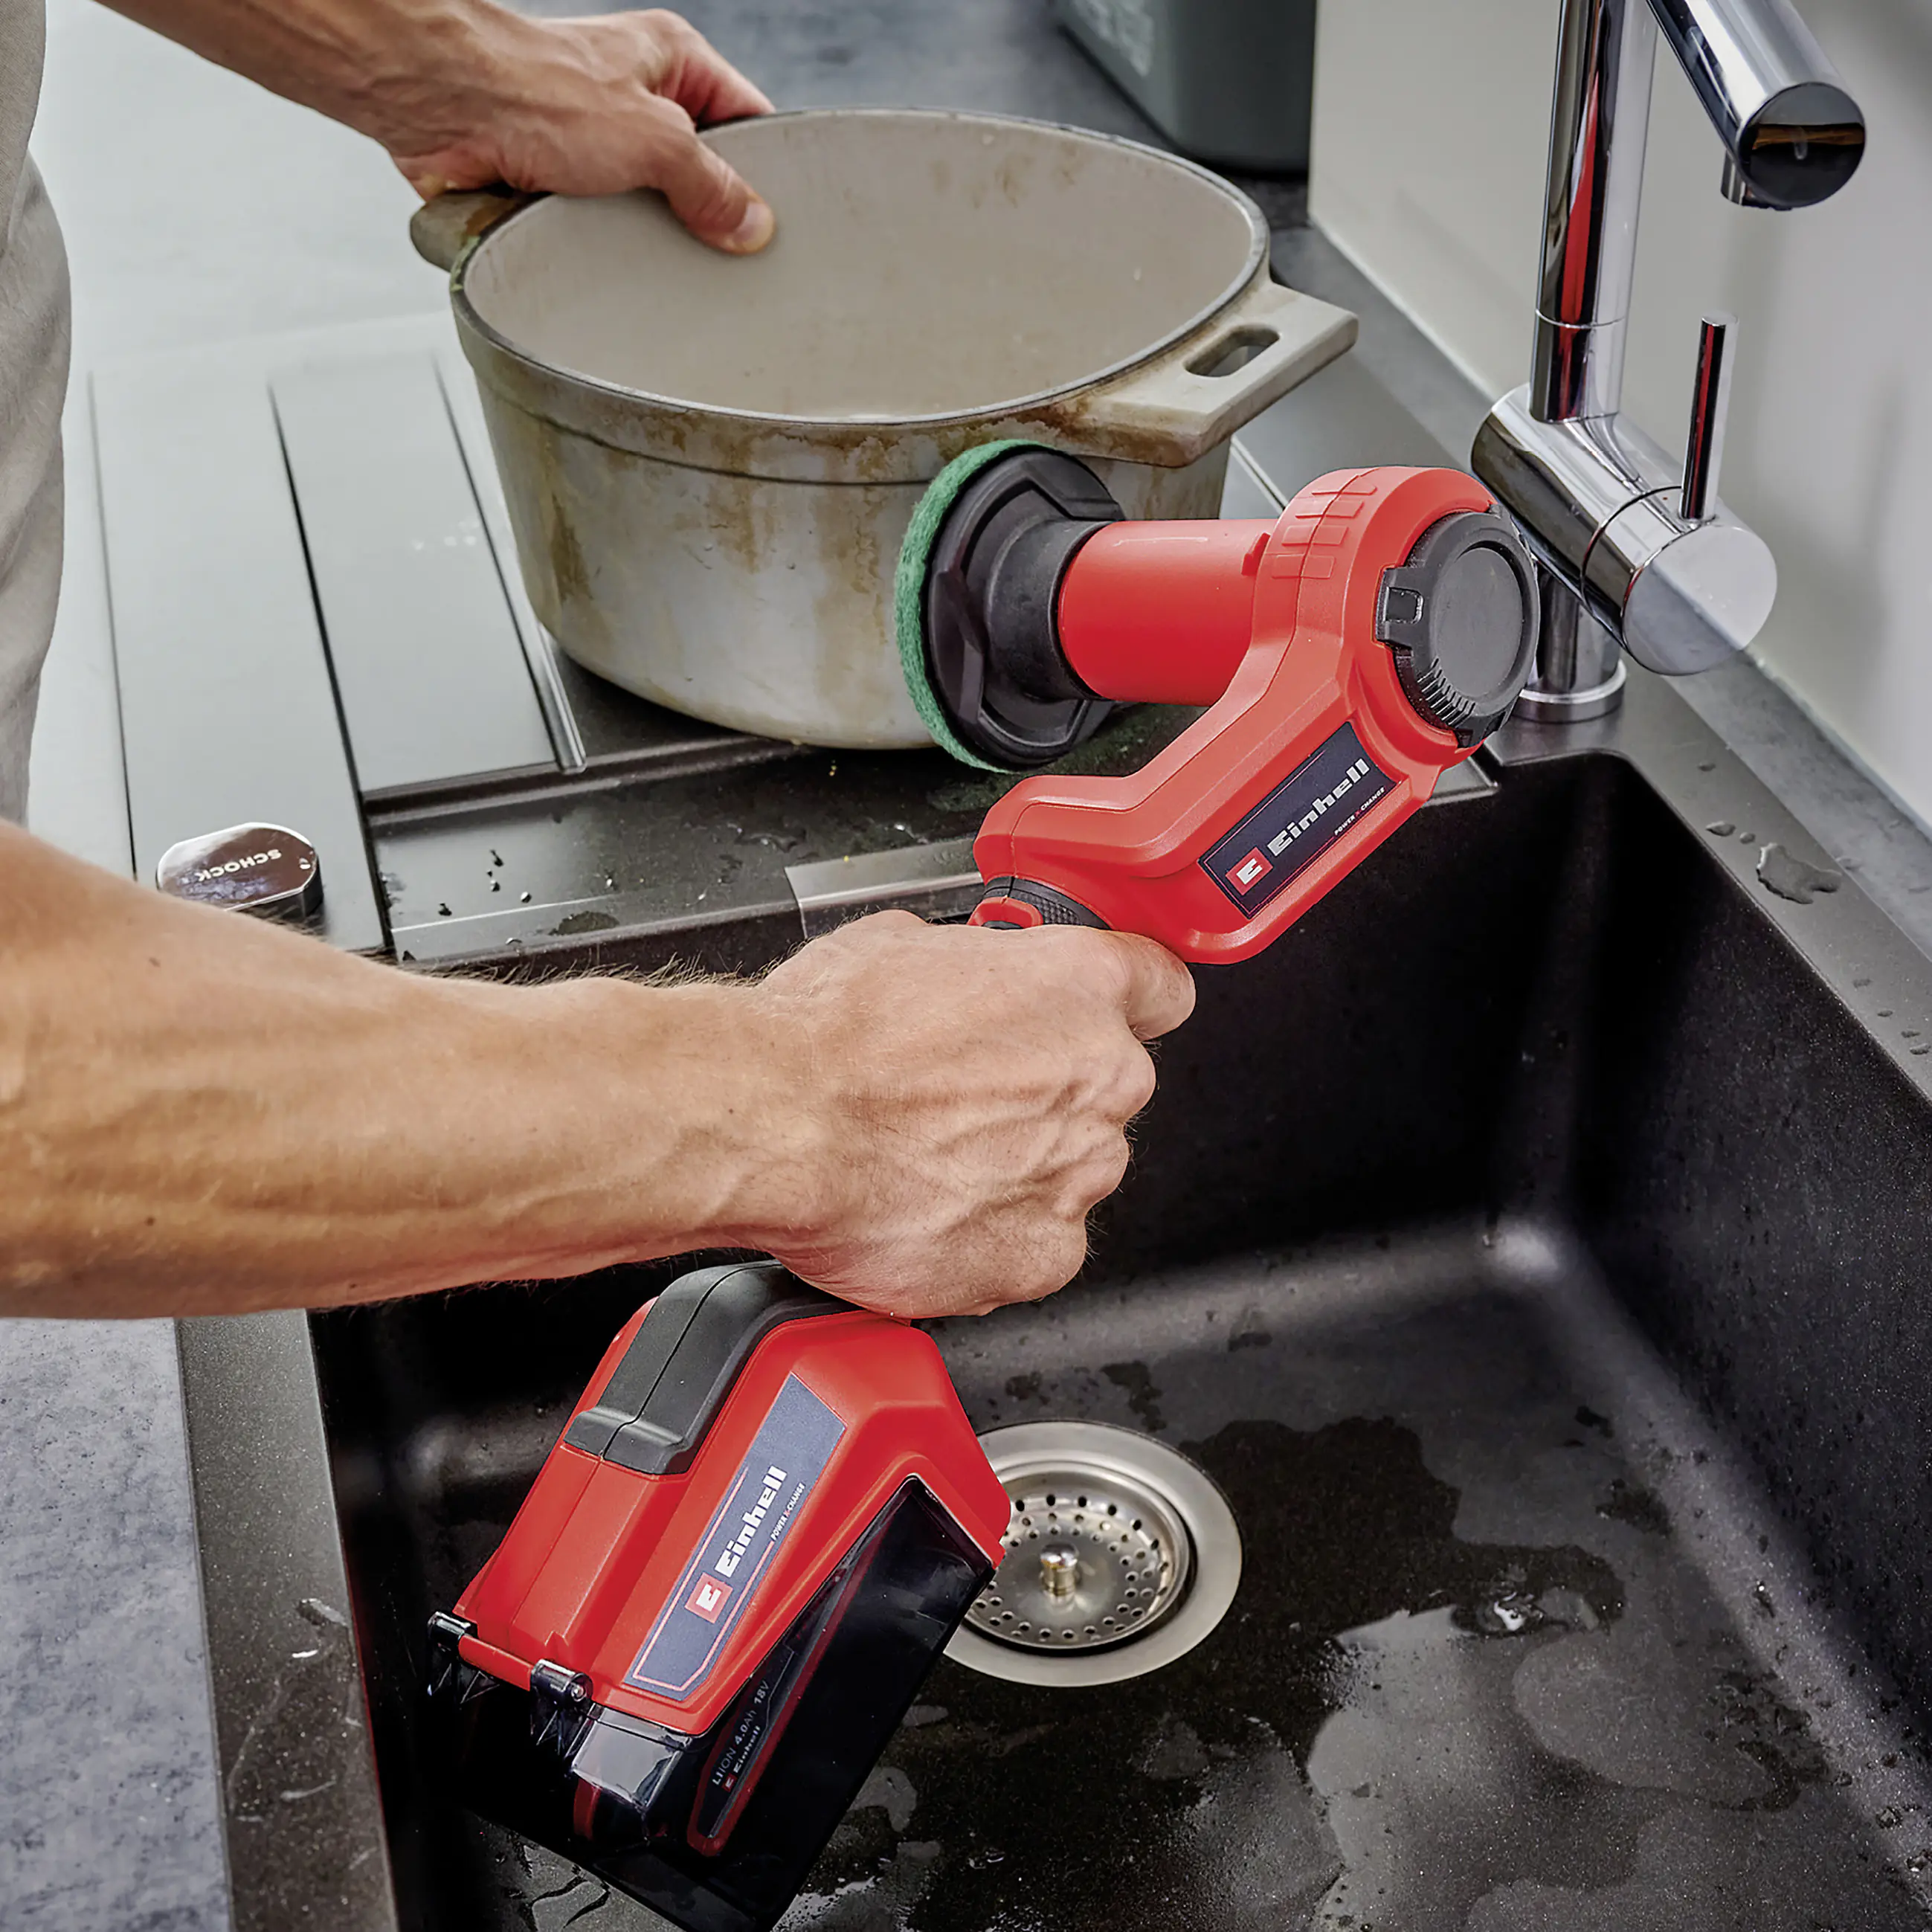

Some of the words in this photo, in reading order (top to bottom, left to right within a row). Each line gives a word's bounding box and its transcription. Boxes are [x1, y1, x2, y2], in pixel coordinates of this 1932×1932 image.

[1267, 759, 1370, 857] Einhell
[195, 849, 283, 882] SCHOCK
[714, 1465, 788, 1578] Einhell
[735, 1710, 757, 1745] 4.0Ah
[753, 1681, 770, 1705] 18V
